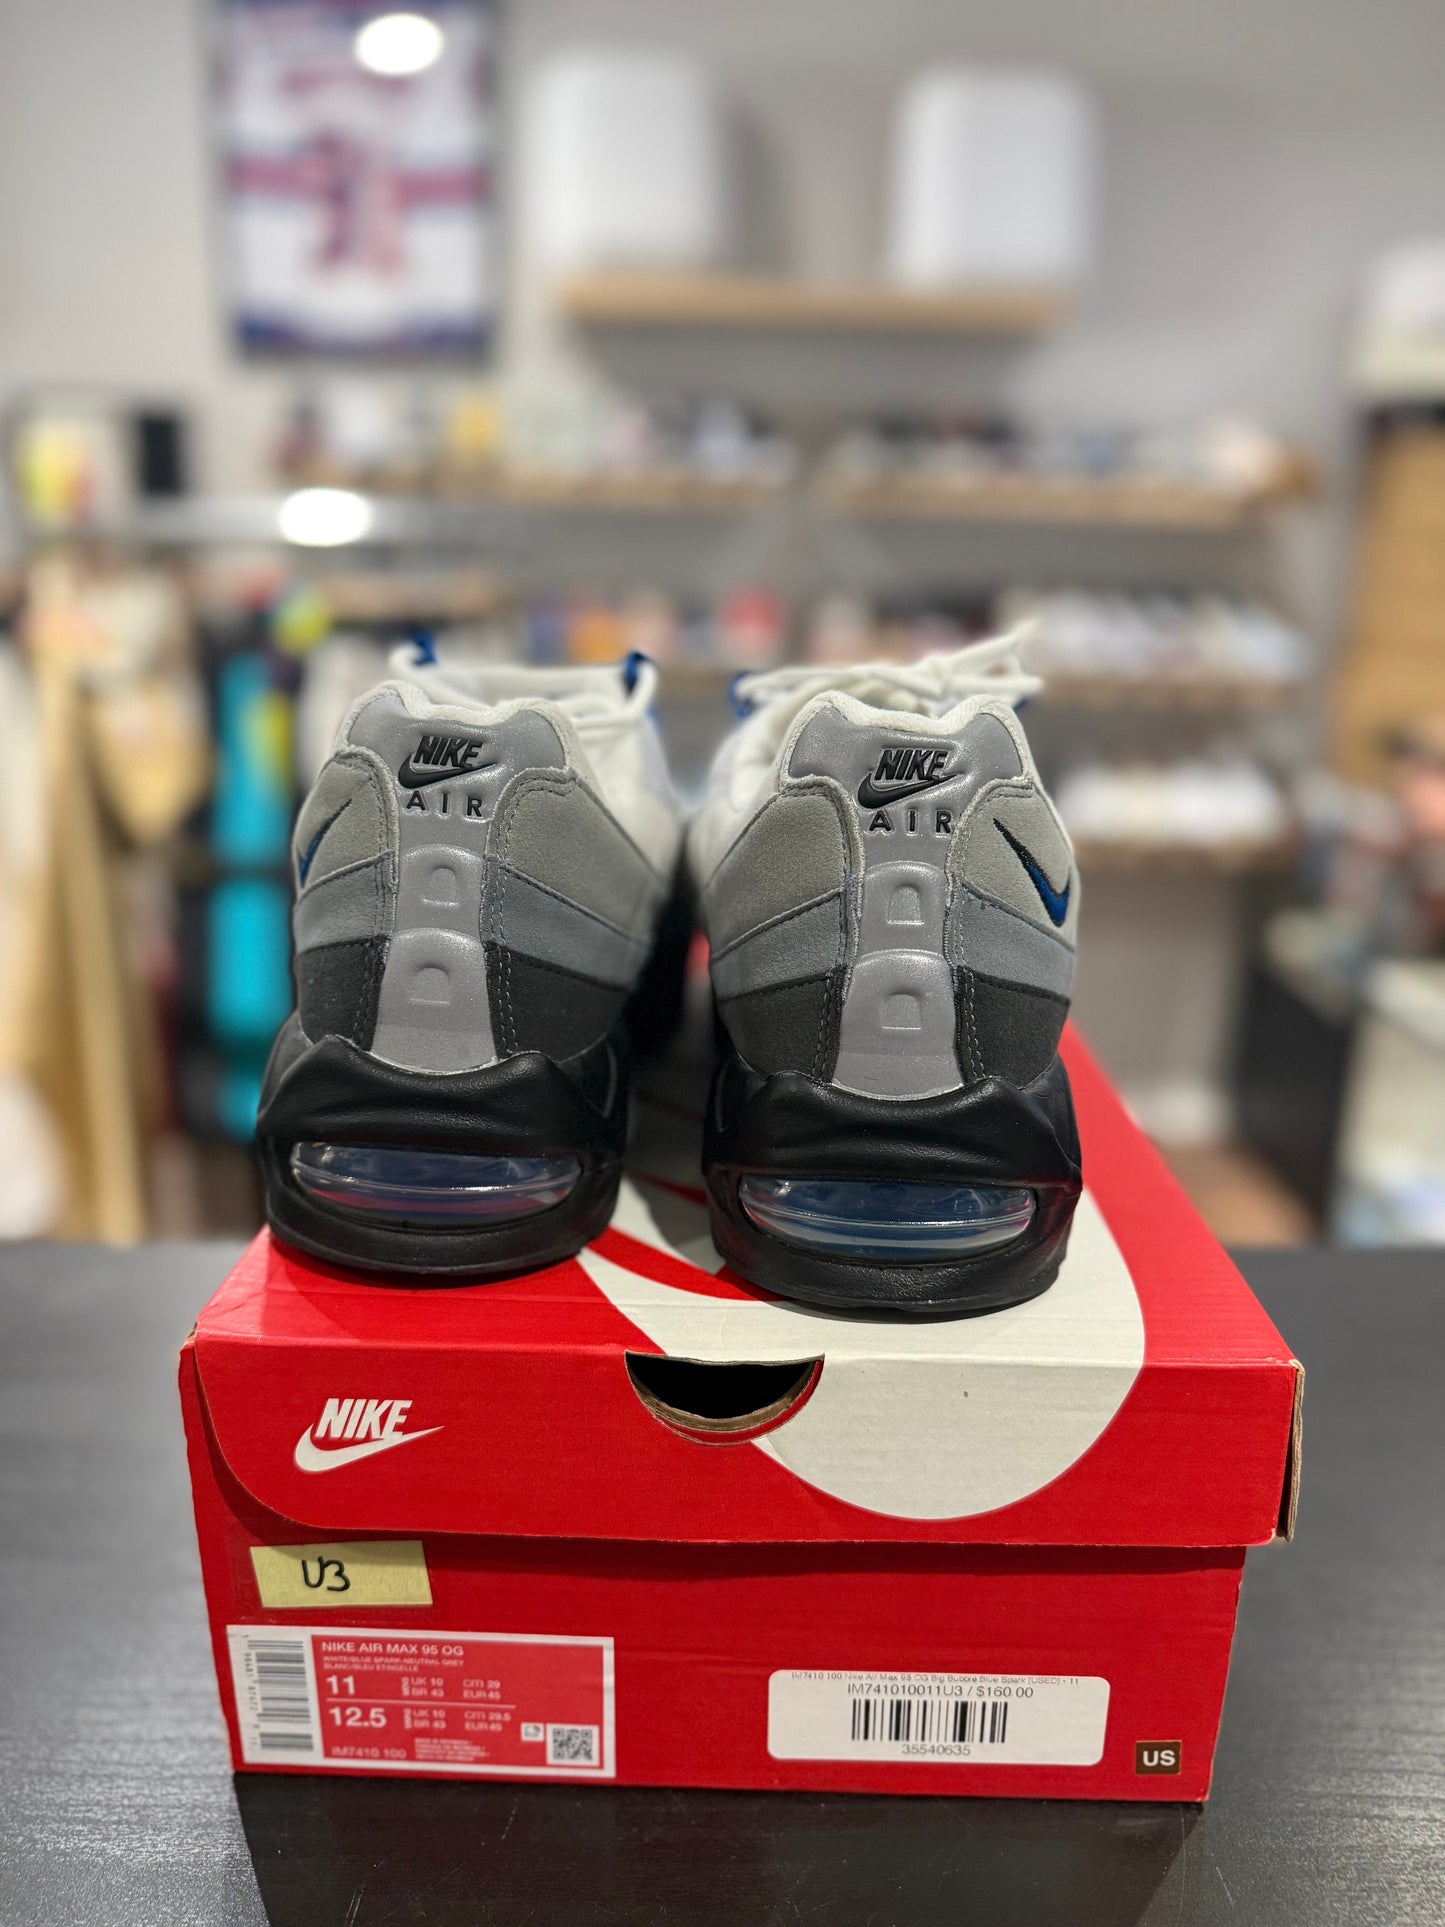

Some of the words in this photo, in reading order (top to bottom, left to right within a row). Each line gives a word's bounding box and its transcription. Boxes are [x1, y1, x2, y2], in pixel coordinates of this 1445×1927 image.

[413, 735, 483, 768] NIKE
[874, 749, 947, 780] NIKE
[406, 790, 482, 817] AIR
[869, 809, 952, 833] AIR
[315, 1398, 413, 1440] NIKE
[301, 1555, 351, 1592] U3
[321, 1641, 355, 1652] NIKE
[359, 1642, 383, 1653] AIR
[386, 1643, 418, 1654] MAX
[421, 1644, 439, 1655] 95
[442, 1645, 464, 1656] OG
[442, 1658, 465, 1667] GREY
[411, 1677, 427, 1686] UK
[431, 1677, 444, 1686] 10
[487, 1680, 500, 1689] 29
[791, 1671, 824, 1679] IM7410
[827, 1672, 843, 1680] 100
[844, 1672, 864, 1680] Nike
[931, 1675, 945, 1684] Big
[947, 1675, 978, 1683] Bubble
[1001, 1676, 1026, 1684] Spark
[326, 1675, 355, 1695] 11
[847, 1683, 963, 1696] IM741010011U3
[967, 1685, 973, 1697] /
[976, 1686, 1034, 1698] $160.00
[431, 1688, 444, 1697] 43
[463, 1690, 487, 1699] EUR
[487, 1690, 501, 1700] 45
[328, 1706, 387, 1728] 12.5
[412, 1709, 429, 1718] UK
[432, 1710, 446, 1719] 10
[488, 1712, 511, 1721] 29.5
[465, 1721, 488, 1730] EUR
[489, 1722, 502, 1731] 45
[331, 1746, 380, 1757] IM7410
[383, 1748, 407, 1759] 100
[901, 1743, 971, 1756] 35540635
[1142, 1750, 1176, 1767] US
